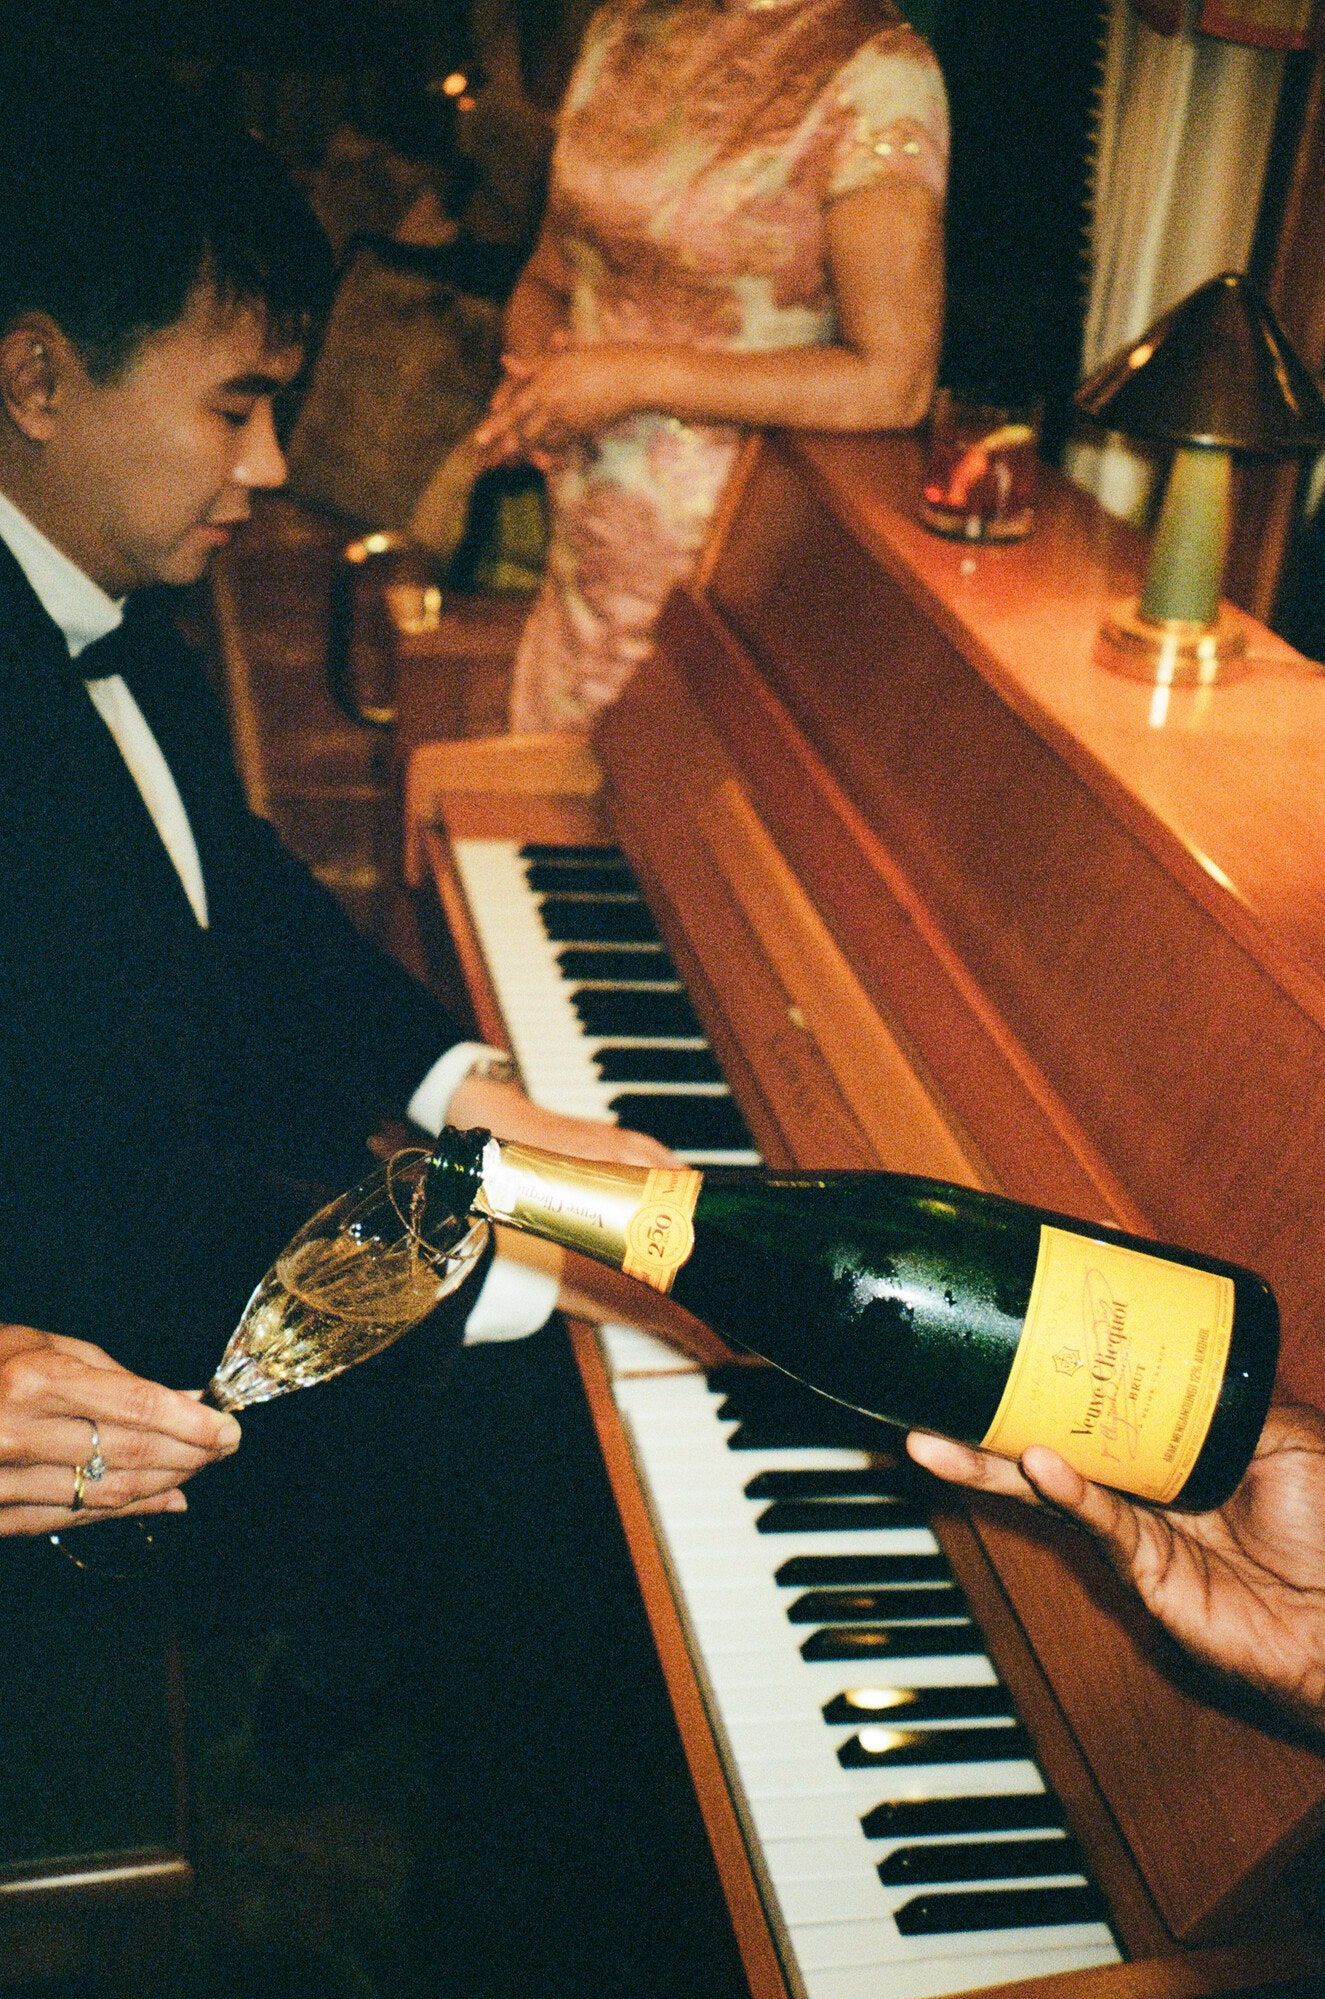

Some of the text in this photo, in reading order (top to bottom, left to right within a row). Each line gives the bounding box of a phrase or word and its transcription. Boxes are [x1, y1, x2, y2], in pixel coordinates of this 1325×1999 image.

[566, 1204, 604, 1229] Veuve
[647, 1213, 673, 1259] 250
[1069, 1387, 1106, 1435] Veuve
[1091, 1300, 1128, 1381] Clicquot
[1128, 1362, 1146, 1401] BRUT
